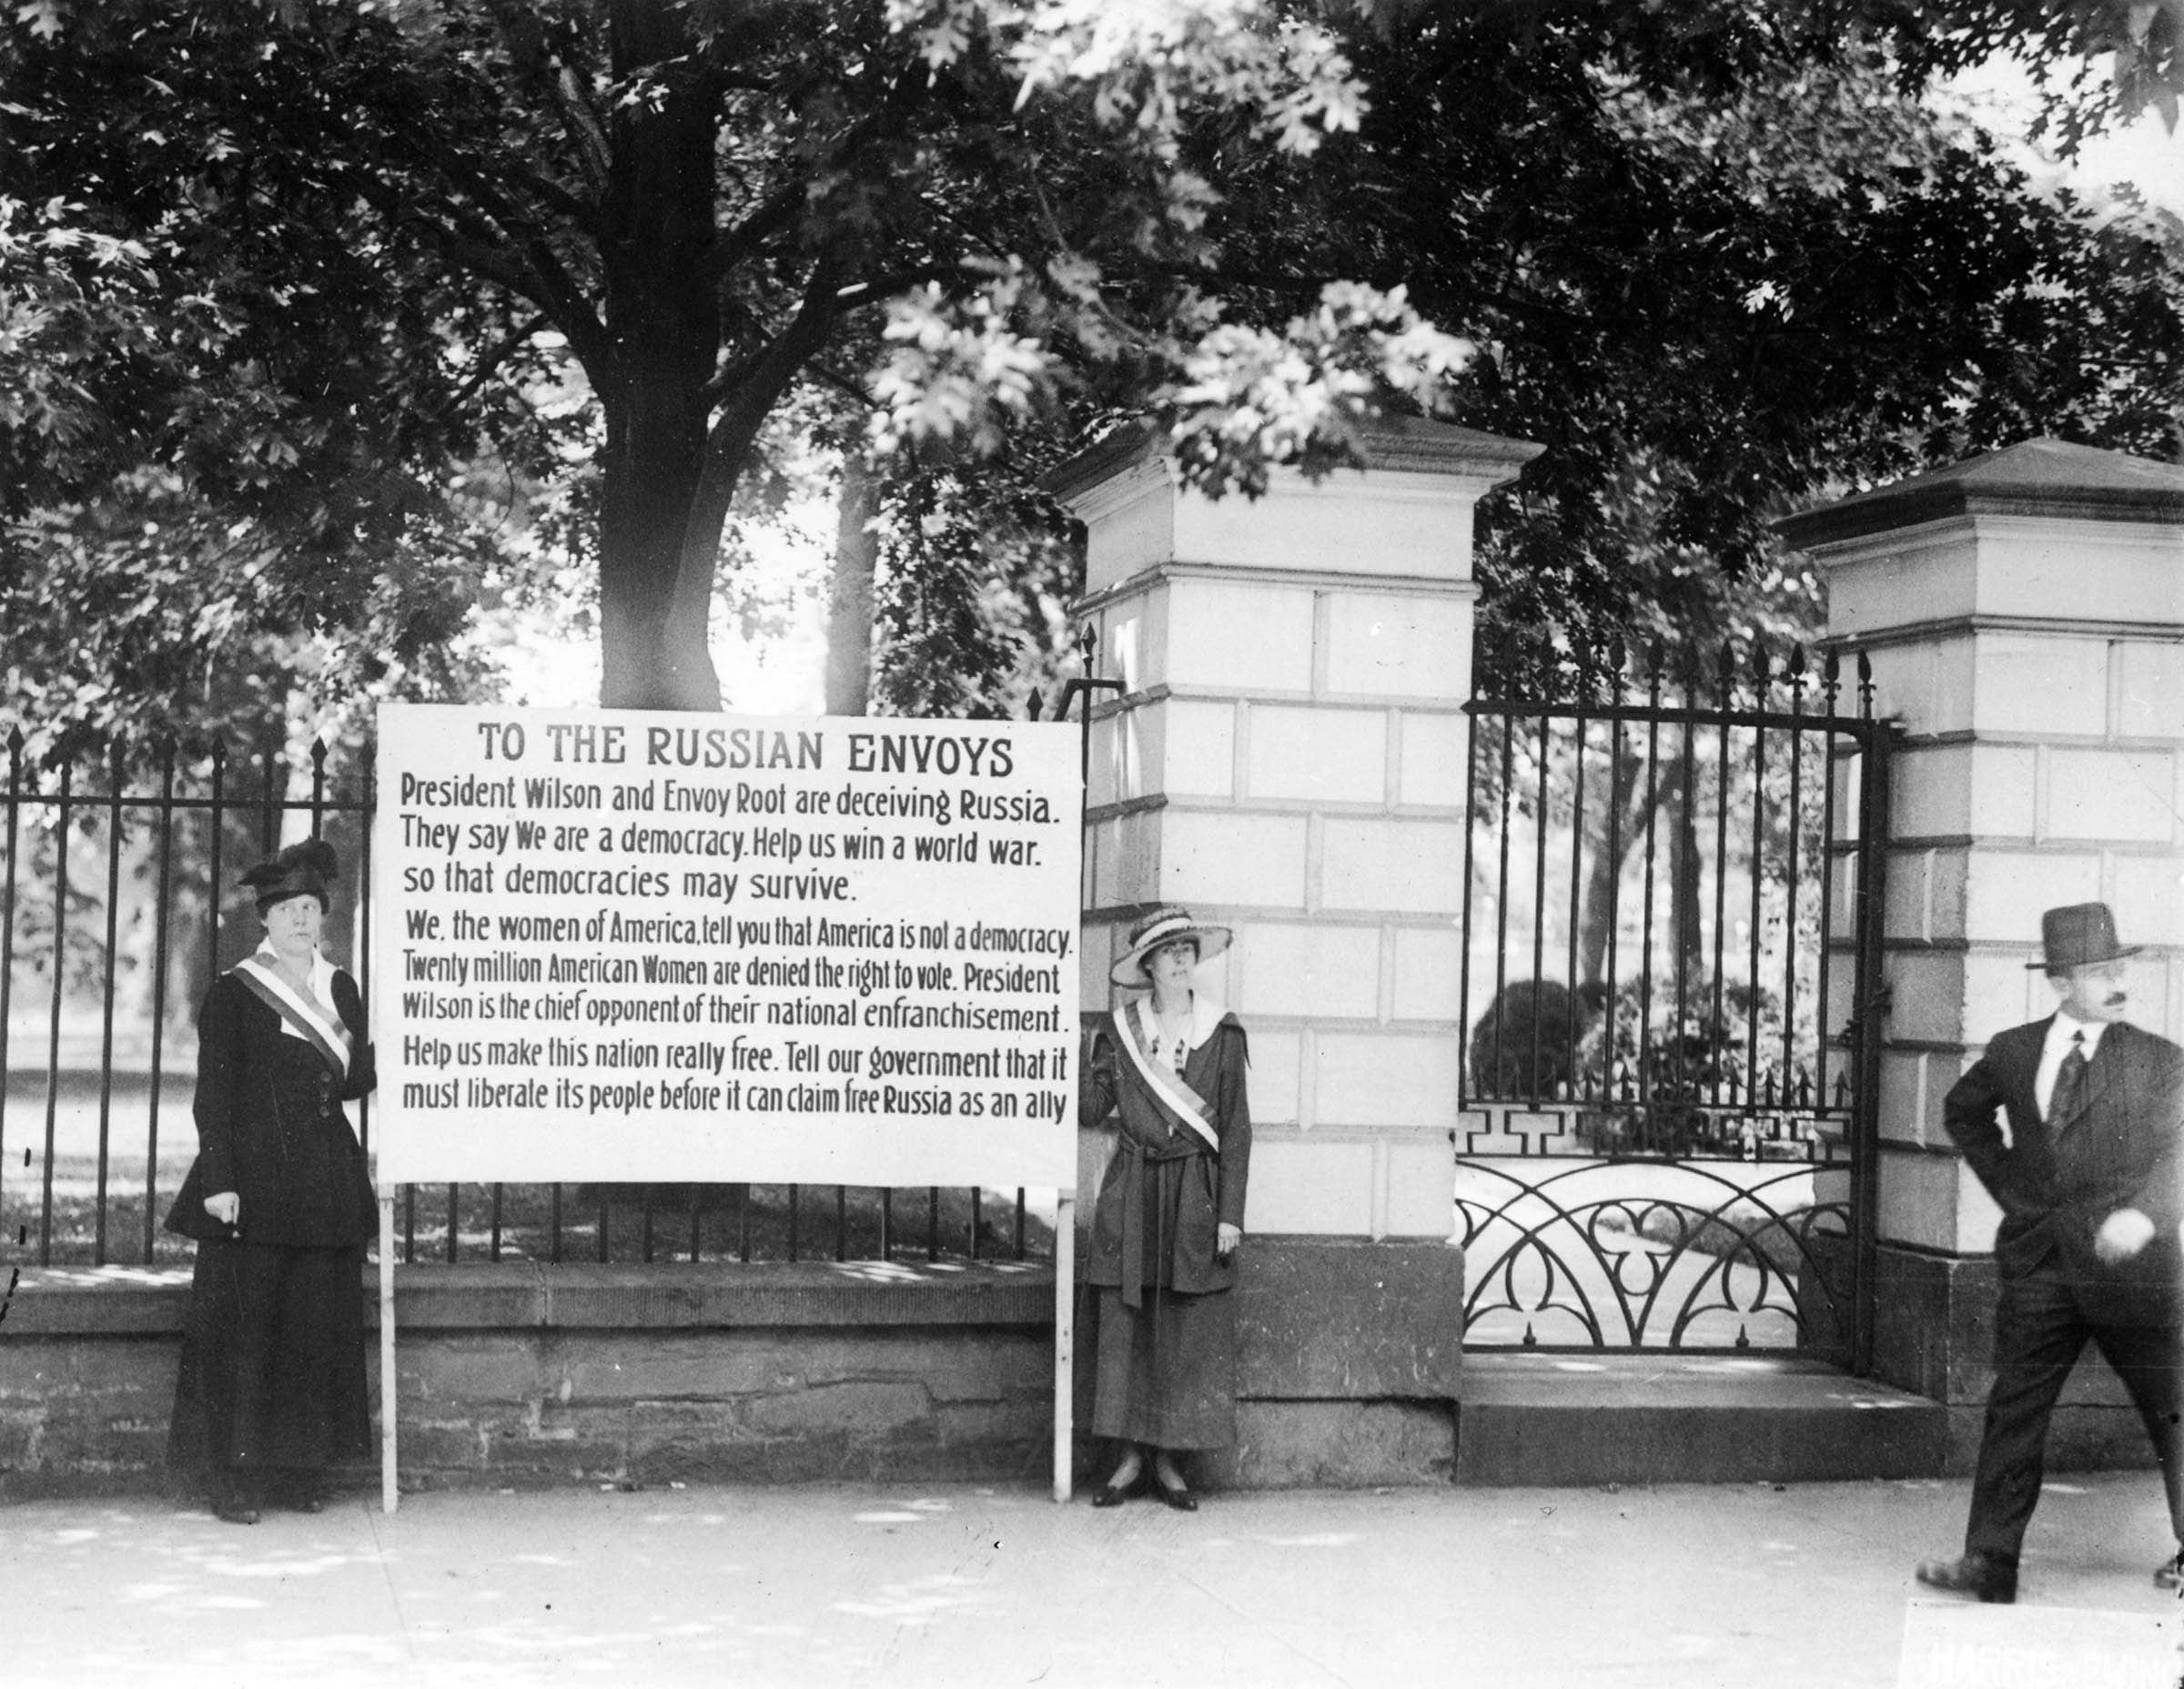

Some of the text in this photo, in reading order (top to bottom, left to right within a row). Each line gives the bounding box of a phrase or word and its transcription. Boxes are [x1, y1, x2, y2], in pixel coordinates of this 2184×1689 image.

[478, 722, 1014, 778] TO THE RUSSIAN ENVOYS
[400, 771, 1060, 826] President Wilson and Envoy Root are deceiving Russia.
[399, 814, 1042, 866] They say We are a democracy. Help us win a world war.
[403, 866, 435, 893] so
[444, 860, 495, 894] that
[505, 862, 670, 898] democracies
[682, 872, 739, 905] may
[452, 909, 490, 941] the
[498, 915, 581, 943] women
[585, 907, 609, 943] of
[702, 914, 733, 946] tell
[736, 921, 771, 950] you
[774, 915, 813, 946] that
[816, 916, 895, 949] America
[899, 918, 916, 950] is
[919, 919, 949, 951] not
[954, 925, 966, 951] a
[969, 920, 1074, 961] democracy.
[402, 948, 1061, 998] Twenty million American Women are denied the right to vote. President
[402, 988, 1069, 1033] Wilson is the chief opponent of their national enfranchisement.
[403, 1034, 1068, 1081] Help us make this nation really free. Tell our government that it
[402, 1077, 1067, 1126] must liberate its people before it can claim free Russia as an ally
